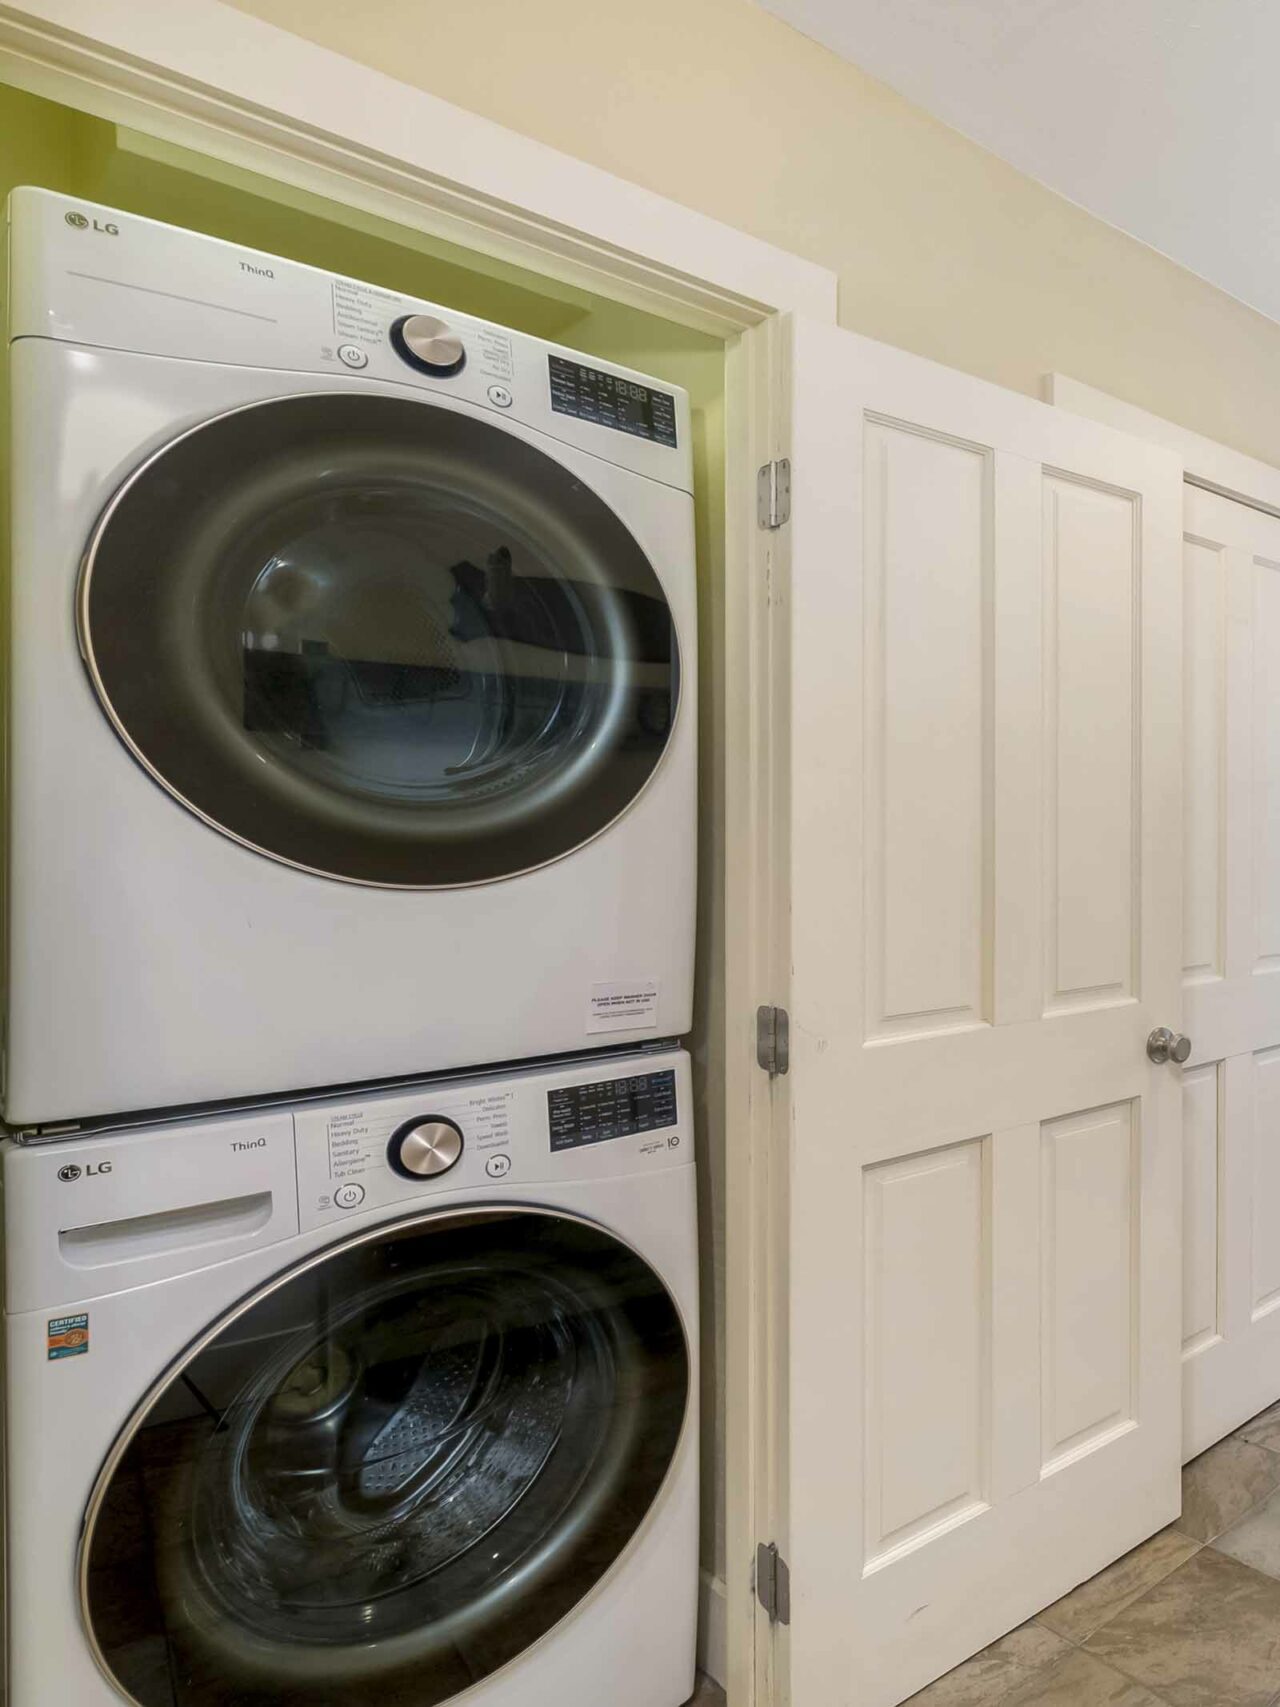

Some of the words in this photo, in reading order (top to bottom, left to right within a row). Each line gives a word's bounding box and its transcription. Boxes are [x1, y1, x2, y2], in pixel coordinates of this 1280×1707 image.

[93, 218, 119, 236] LG
[239, 261, 275, 279] ThinQ
[230, 1138, 267, 1152] ThinQ
[86, 1161, 112, 1176] LG
